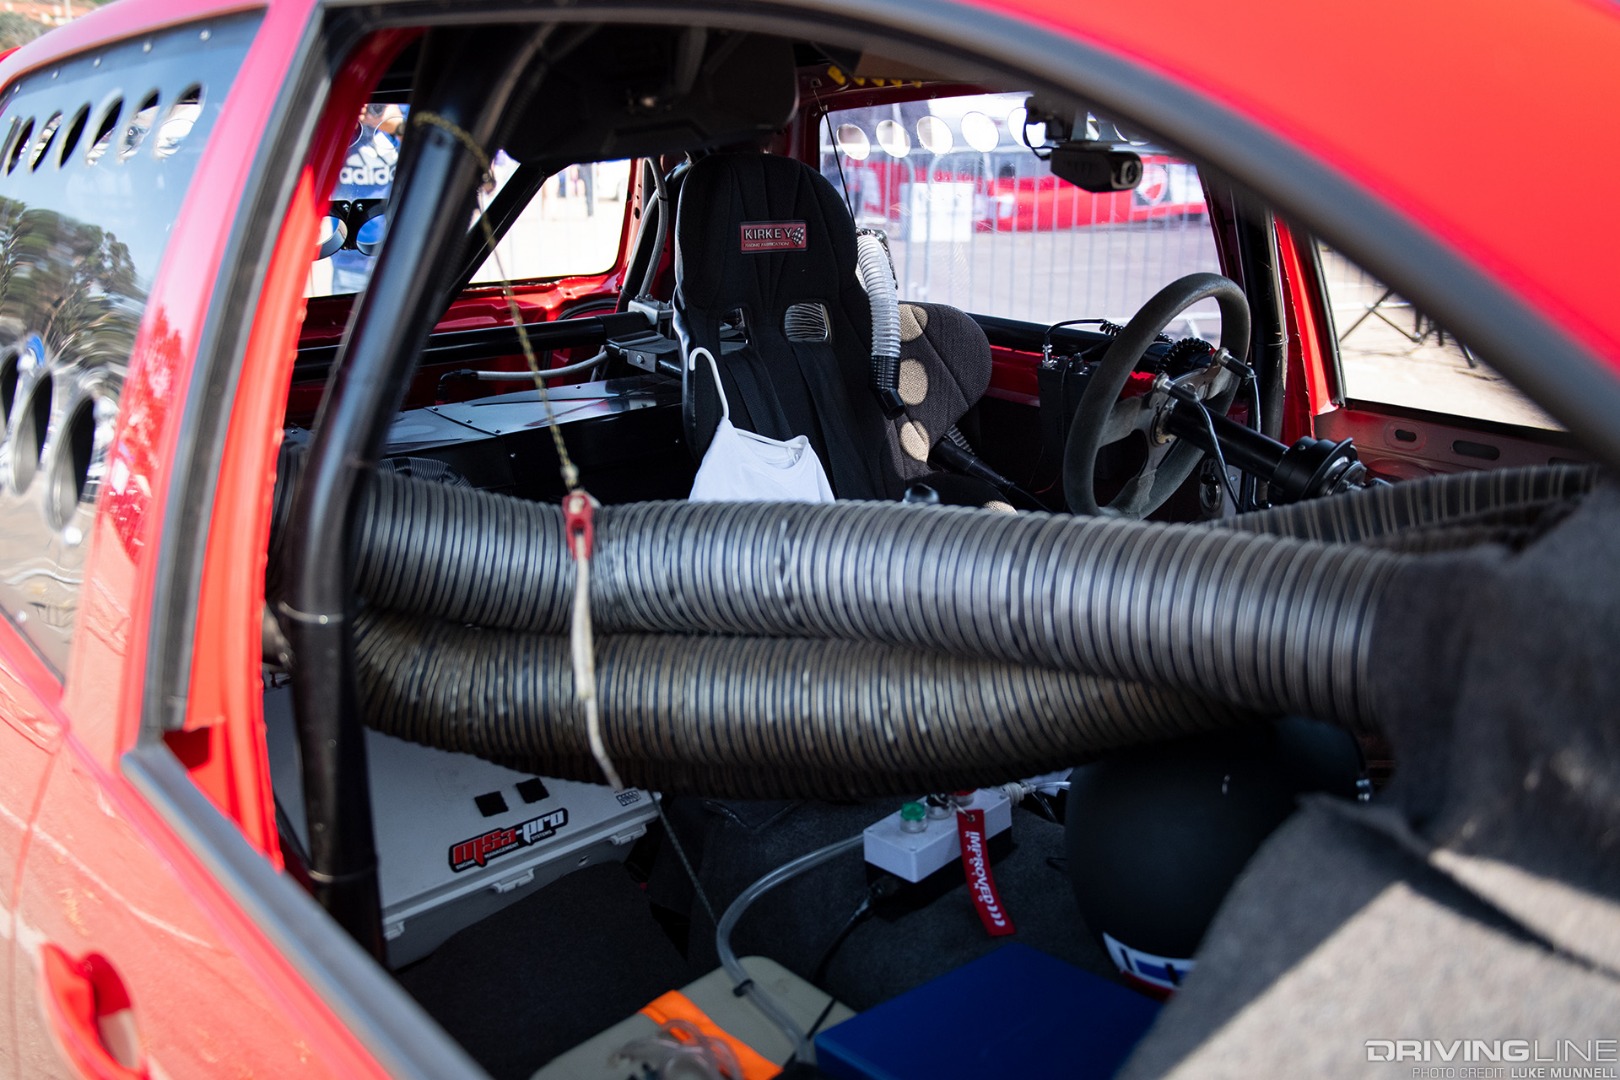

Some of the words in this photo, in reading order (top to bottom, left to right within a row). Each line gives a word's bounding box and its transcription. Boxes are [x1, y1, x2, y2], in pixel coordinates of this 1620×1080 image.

[745, 228, 792, 240] KIRKEY
[484, 841, 519, 858] MANAGEMENT
[531, 829, 553, 840] SYSTEMS
[970, 831, 995, 904] IMPROVED
